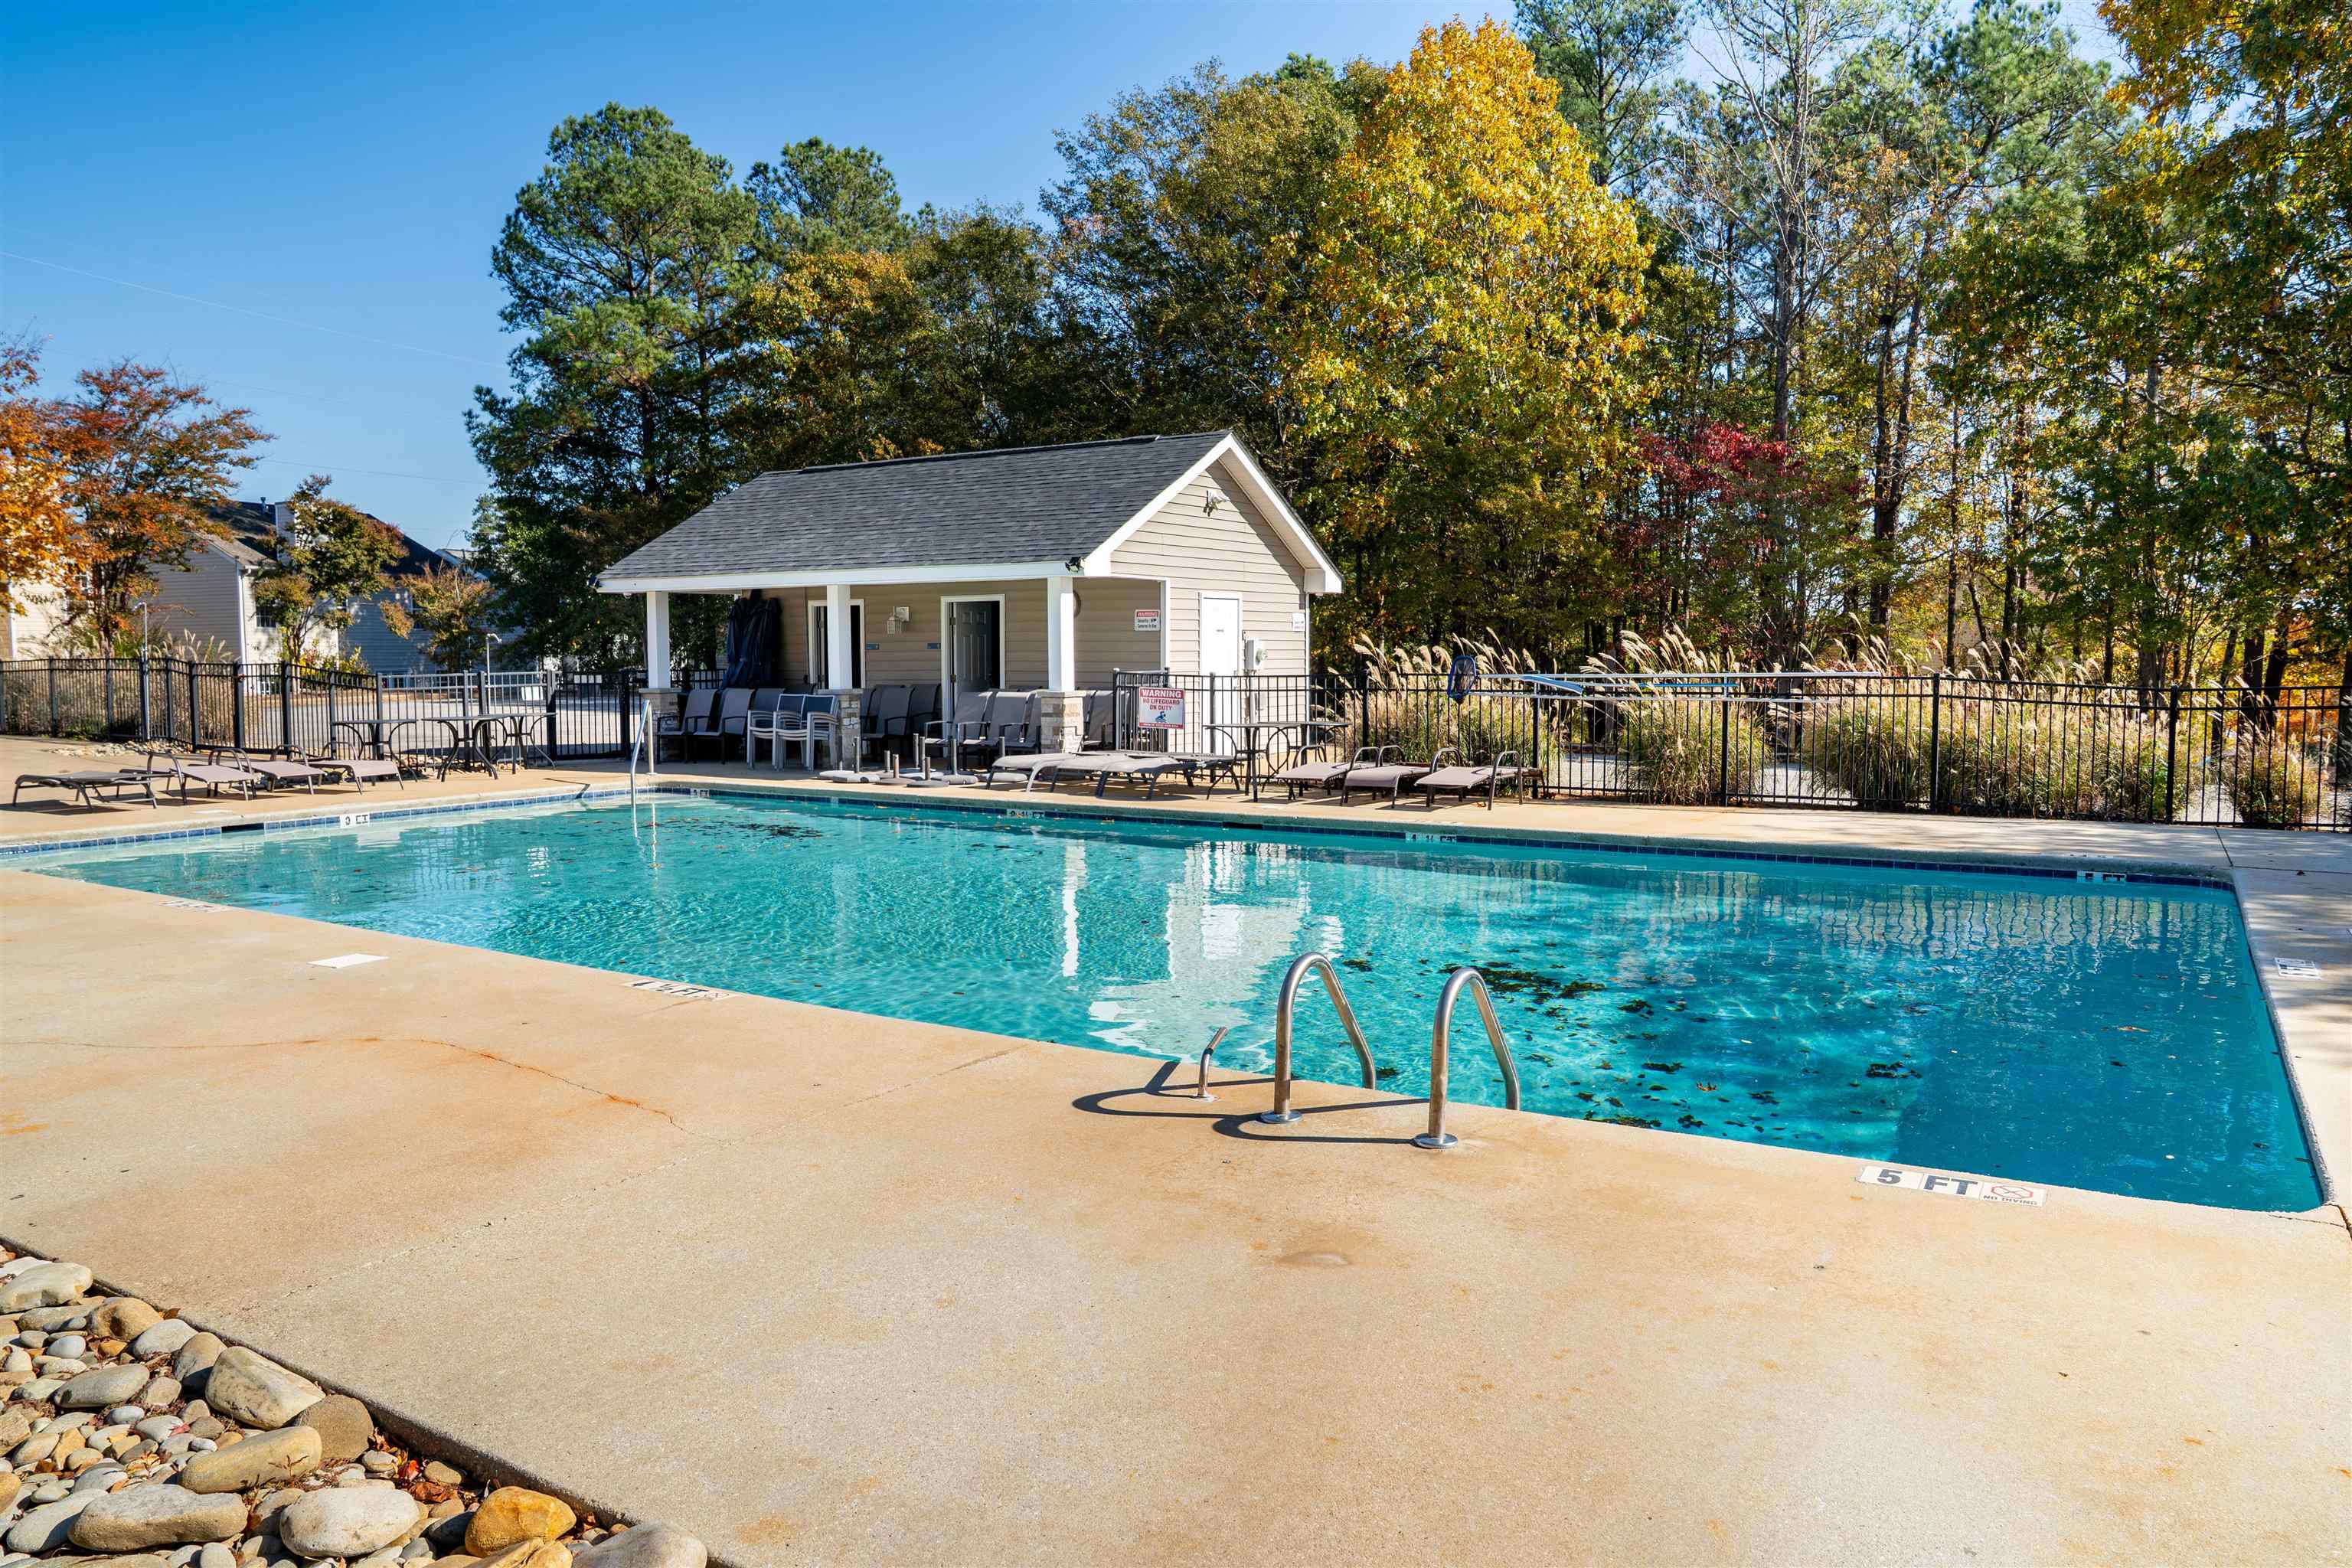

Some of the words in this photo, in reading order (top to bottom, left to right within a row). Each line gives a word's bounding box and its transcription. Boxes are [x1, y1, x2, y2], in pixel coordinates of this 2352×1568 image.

[1142, 689, 1181, 697] WARNING
[1877, 1168, 1903, 1184] 5
[1923, 1174, 1978, 1195] FT
